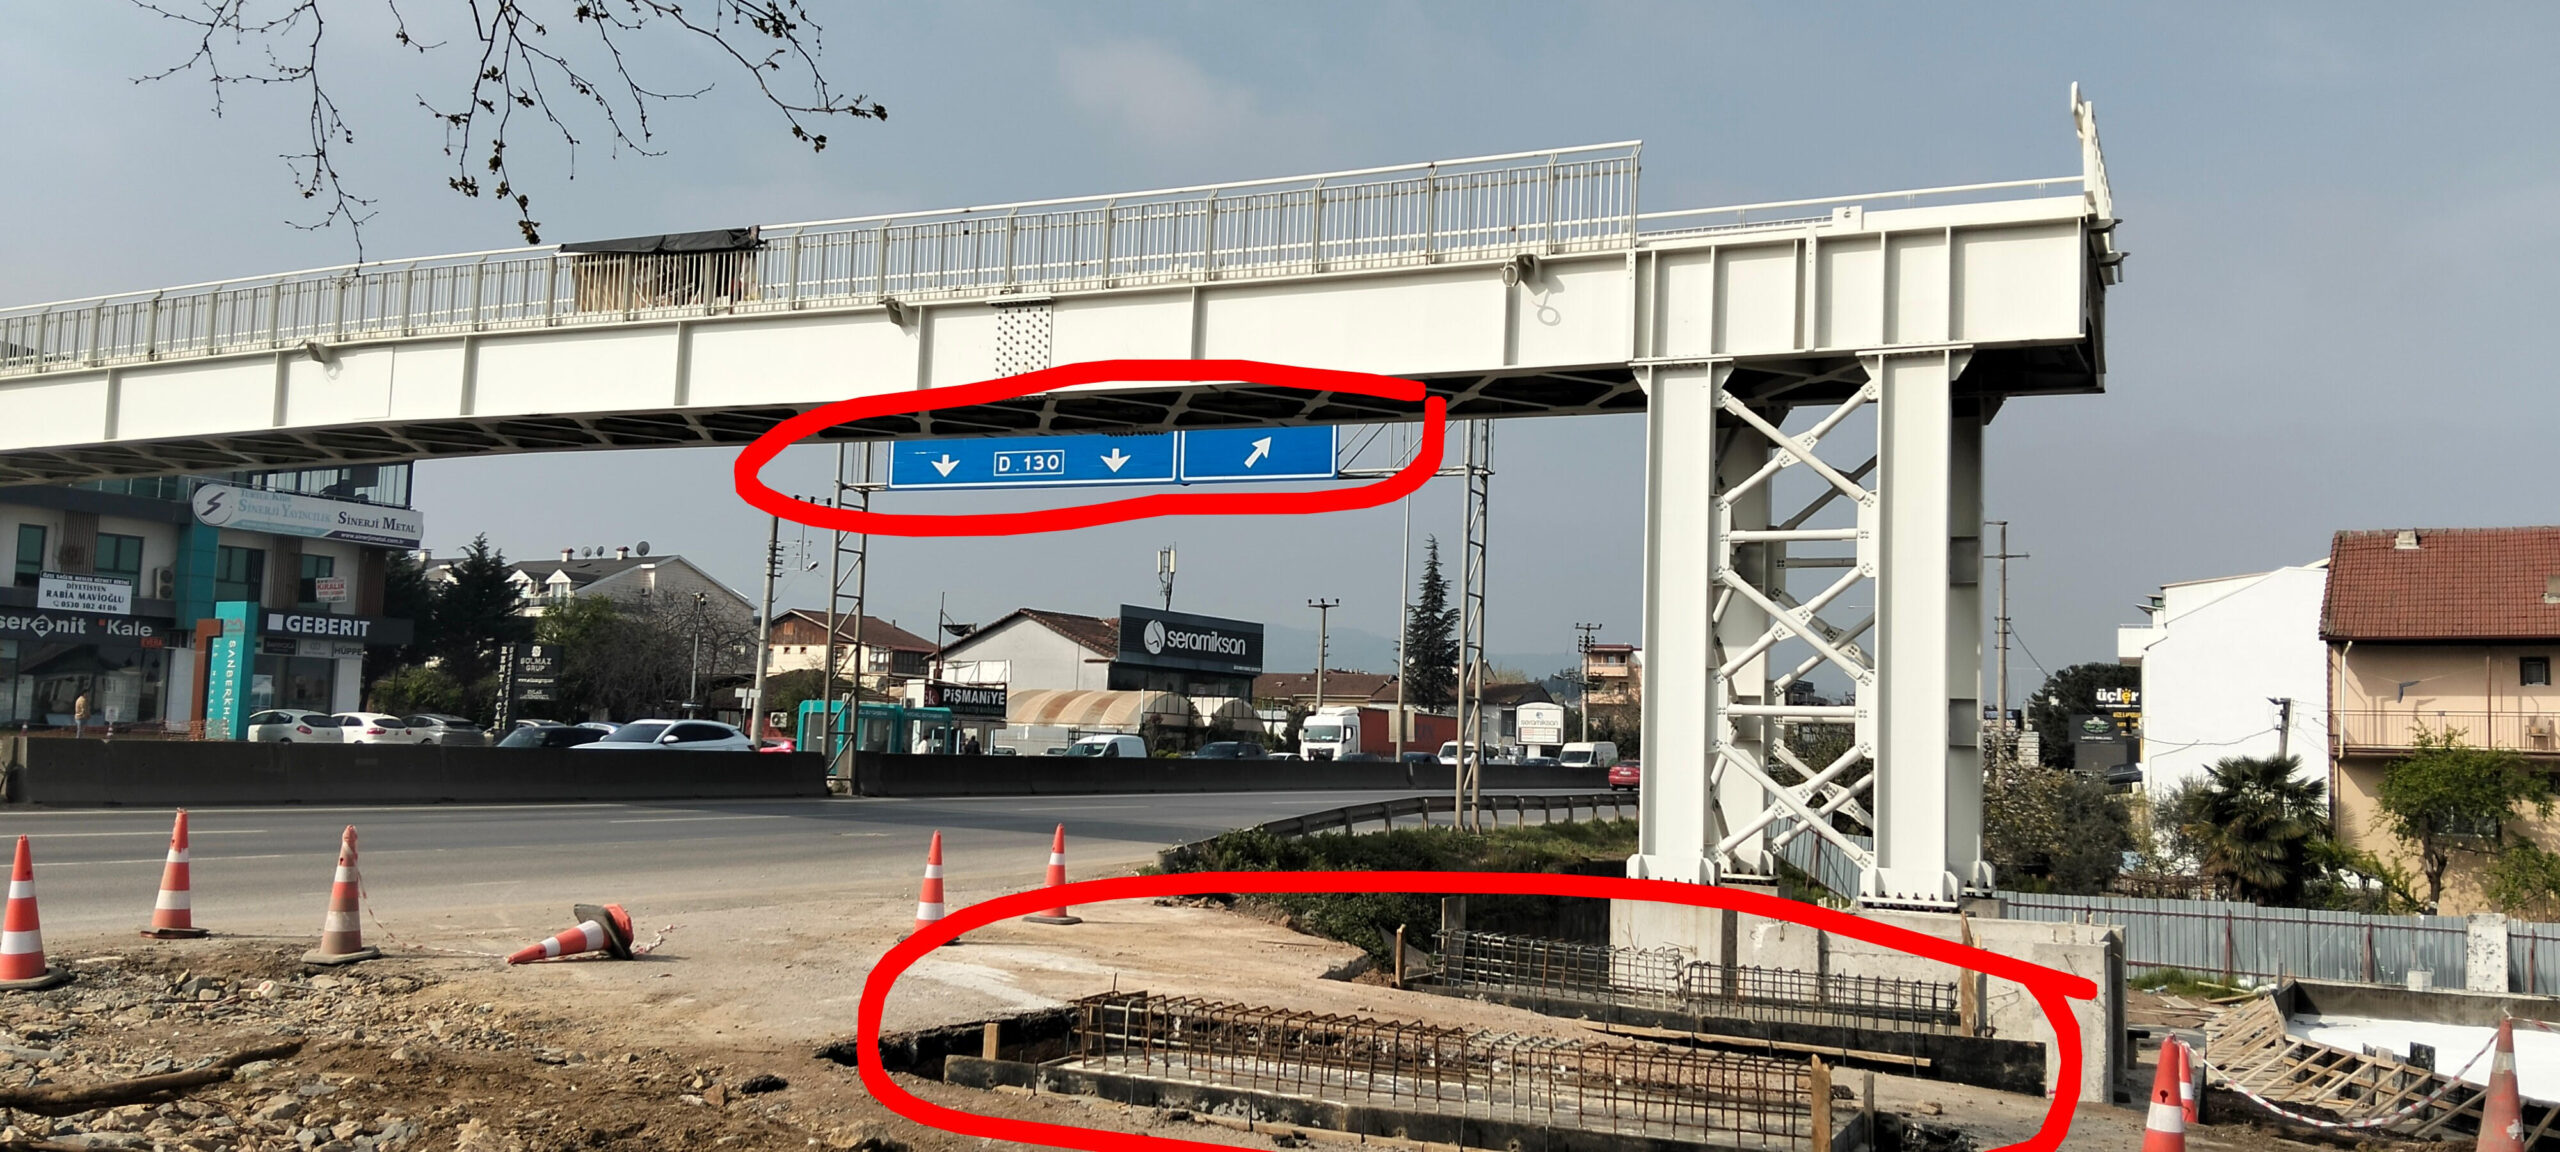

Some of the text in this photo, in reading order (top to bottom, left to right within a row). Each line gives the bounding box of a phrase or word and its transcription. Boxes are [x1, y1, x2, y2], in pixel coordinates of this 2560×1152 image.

[382, 517, 416, 533] METAL
[107, 619, 153, 637] Kale
[286, 615, 371, 637] GEBERIT
[1167, 630, 1246, 655] seramiksan
[2096, 687, 2139, 704] üçler
